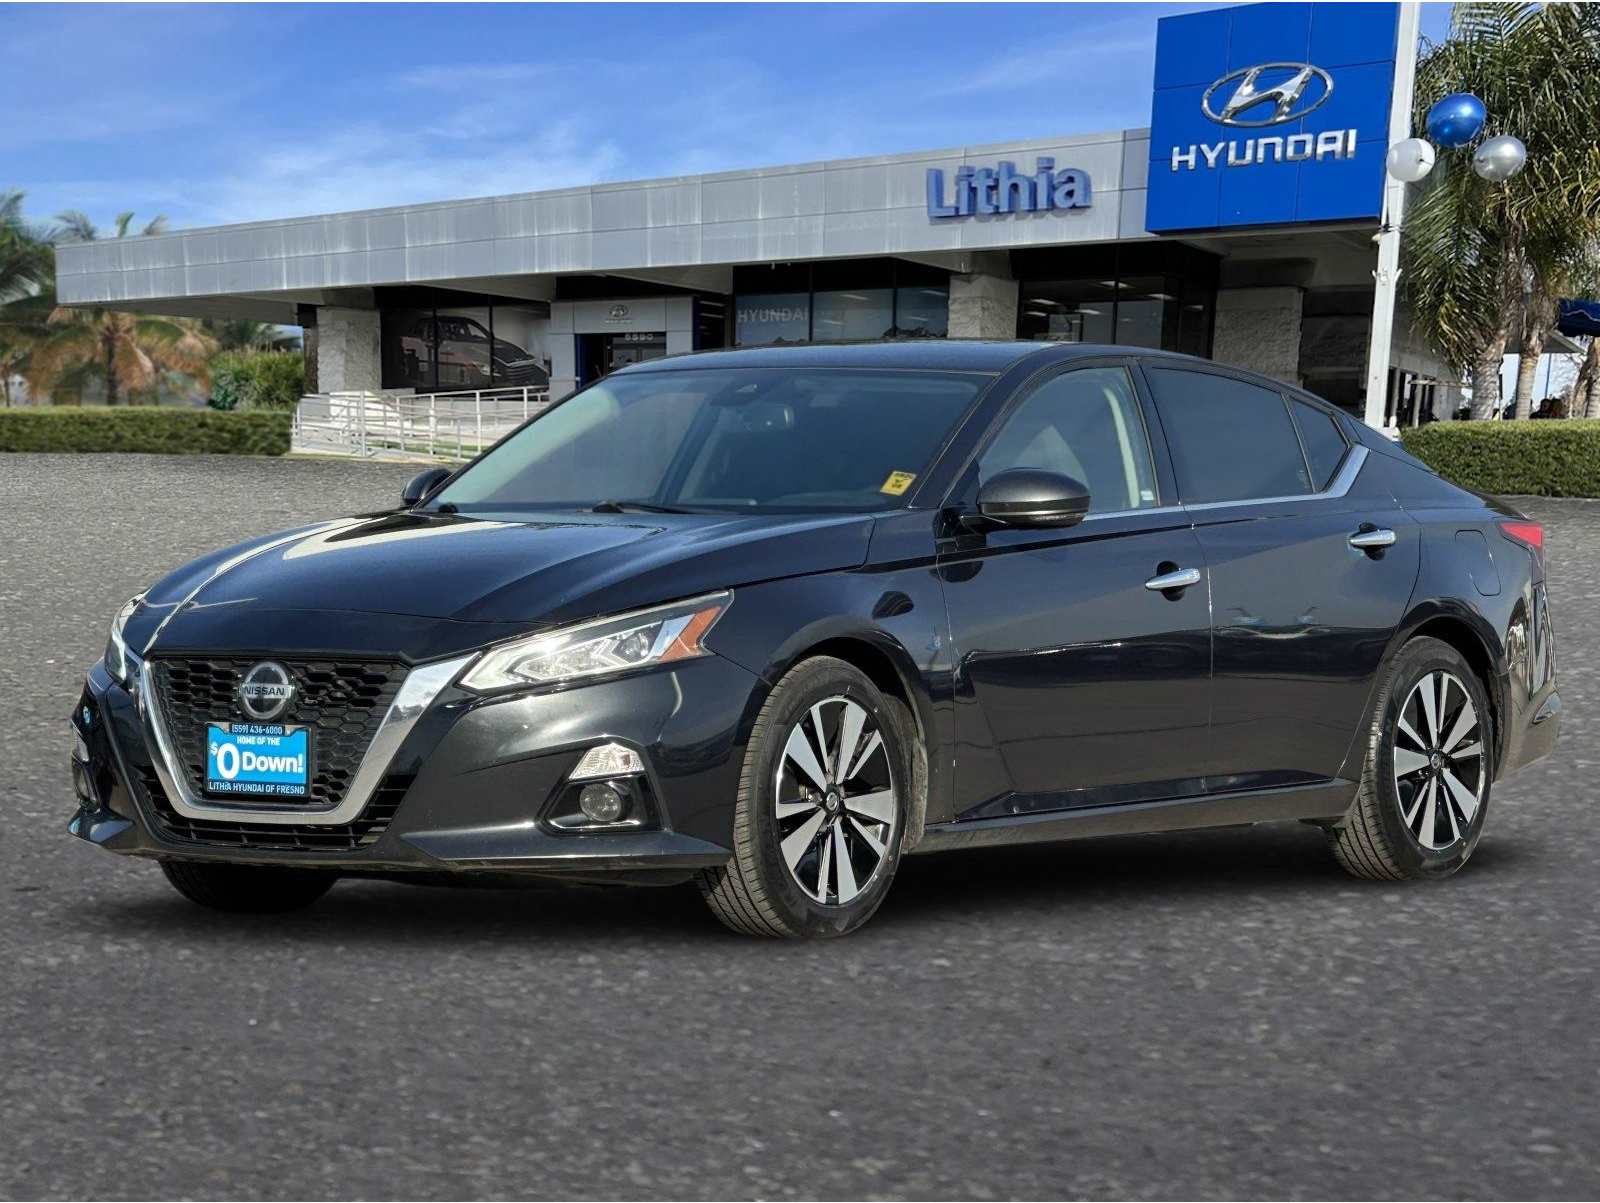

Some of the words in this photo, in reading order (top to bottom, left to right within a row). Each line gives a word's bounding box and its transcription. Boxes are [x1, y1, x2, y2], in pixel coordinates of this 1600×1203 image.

[1171, 128, 1358, 172] HYUNDAI
[927, 157, 1092, 218] Lithia
[737, 306, 810, 323] HYUNDAI
[244, 686, 285, 696] NISSAN
[231, 724, 249, 734] (559)
[250, 724, 283, 735] 436-6000
[237, 736, 255, 745] HOME
[257, 736, 266, 745] OF
[267, 736, 281, 746] THE
[242, 751, 304, 774] Down!
[209, 781, 232, 791] LITHIA
[232, 782, 264, 793] HYUNDAI
[265, 784, 275, 793] OF
[276, 785, 305, 795] FRESNO
